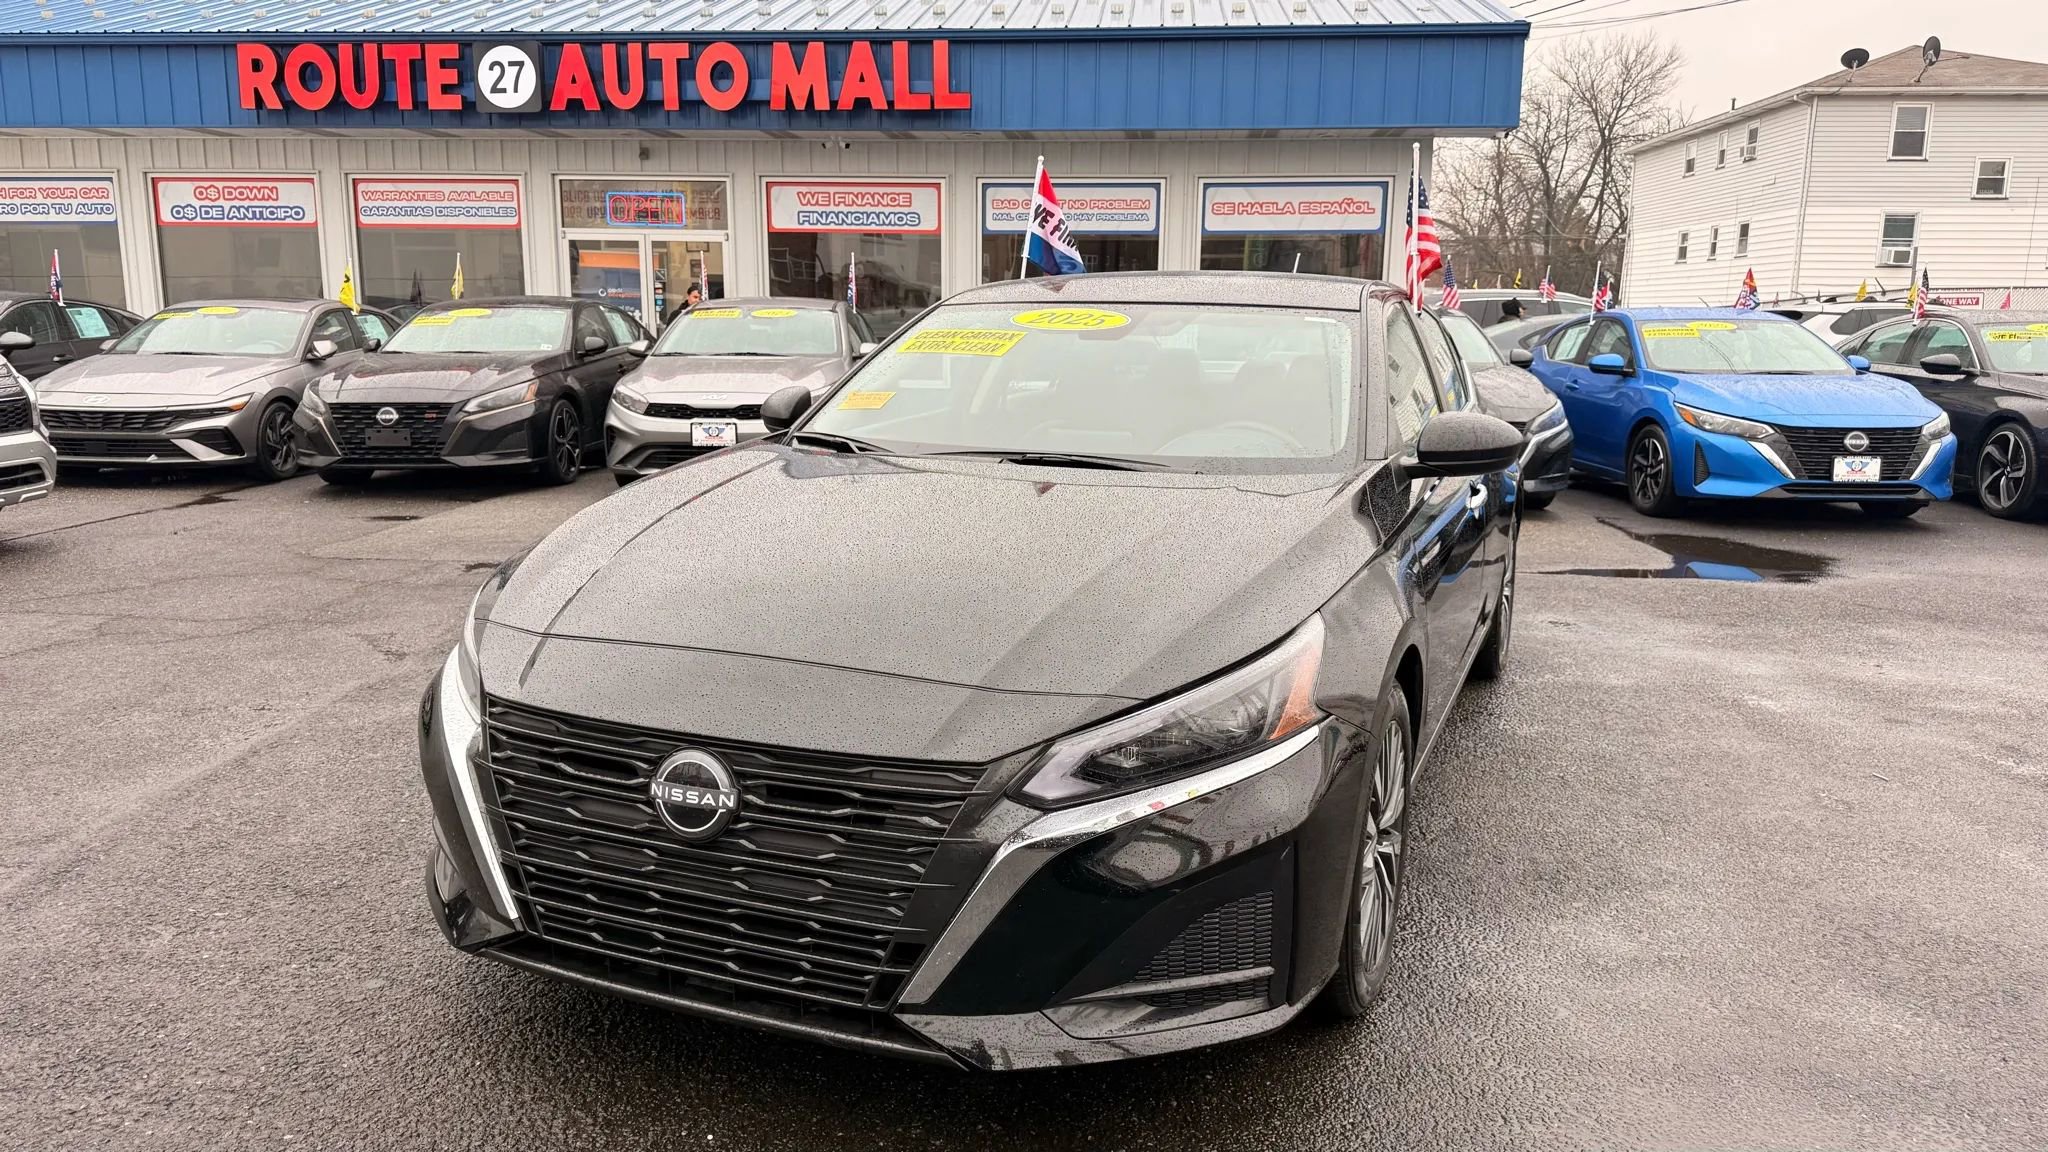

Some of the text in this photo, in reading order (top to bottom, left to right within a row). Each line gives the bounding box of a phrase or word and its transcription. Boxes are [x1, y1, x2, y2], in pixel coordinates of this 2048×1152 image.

[236, 40, 971, 111] ROUTE 27 AUTO MALL
[9, 187, 36, 199] FOR
[39, 187, 77, 199] YOUR
[79, 187, 109, 199] CAR
[222, 186, 279, 201] DOWN
[362, 190, 514, 202] WARRANTIES AVAILABLE
[796, 191, 912, 207] WE FINANCE
[21, 203, 49, 215] POR
[52, 203, 72, 215] TU
[75, 203, 114, 215] AUTO
[360, 206, 517, 218] GARANTIAS DISPONIBLES
[609, 195, 683, 224] OPEN
[991, 199, 1019, 210] BAD
[1068, 199, 1089, 211] NO
[1090, 199, 1151, 211] PROBLEM
[1211, 197, 1376, 215] SE HABLA ESPAÑOL
[199, 205, 224, 220] DE
[227, 205, 305, 221] ANTICIPO
[797, 210, 921, 226] FINANCIAMOS
[991, 212, 1014, 221] MAL
[1073, 212, 1094, 222] HAY
[1095, 212, 1150, 222] PROBLEMA
[1028, 311, 1114, 328] 2025
[915, 331, 1020, 341] CLEAN CARFAX
[904, 340, 1006, 353] EXTRA CLEAN
[651, 781, 735, 808] NISSAN
